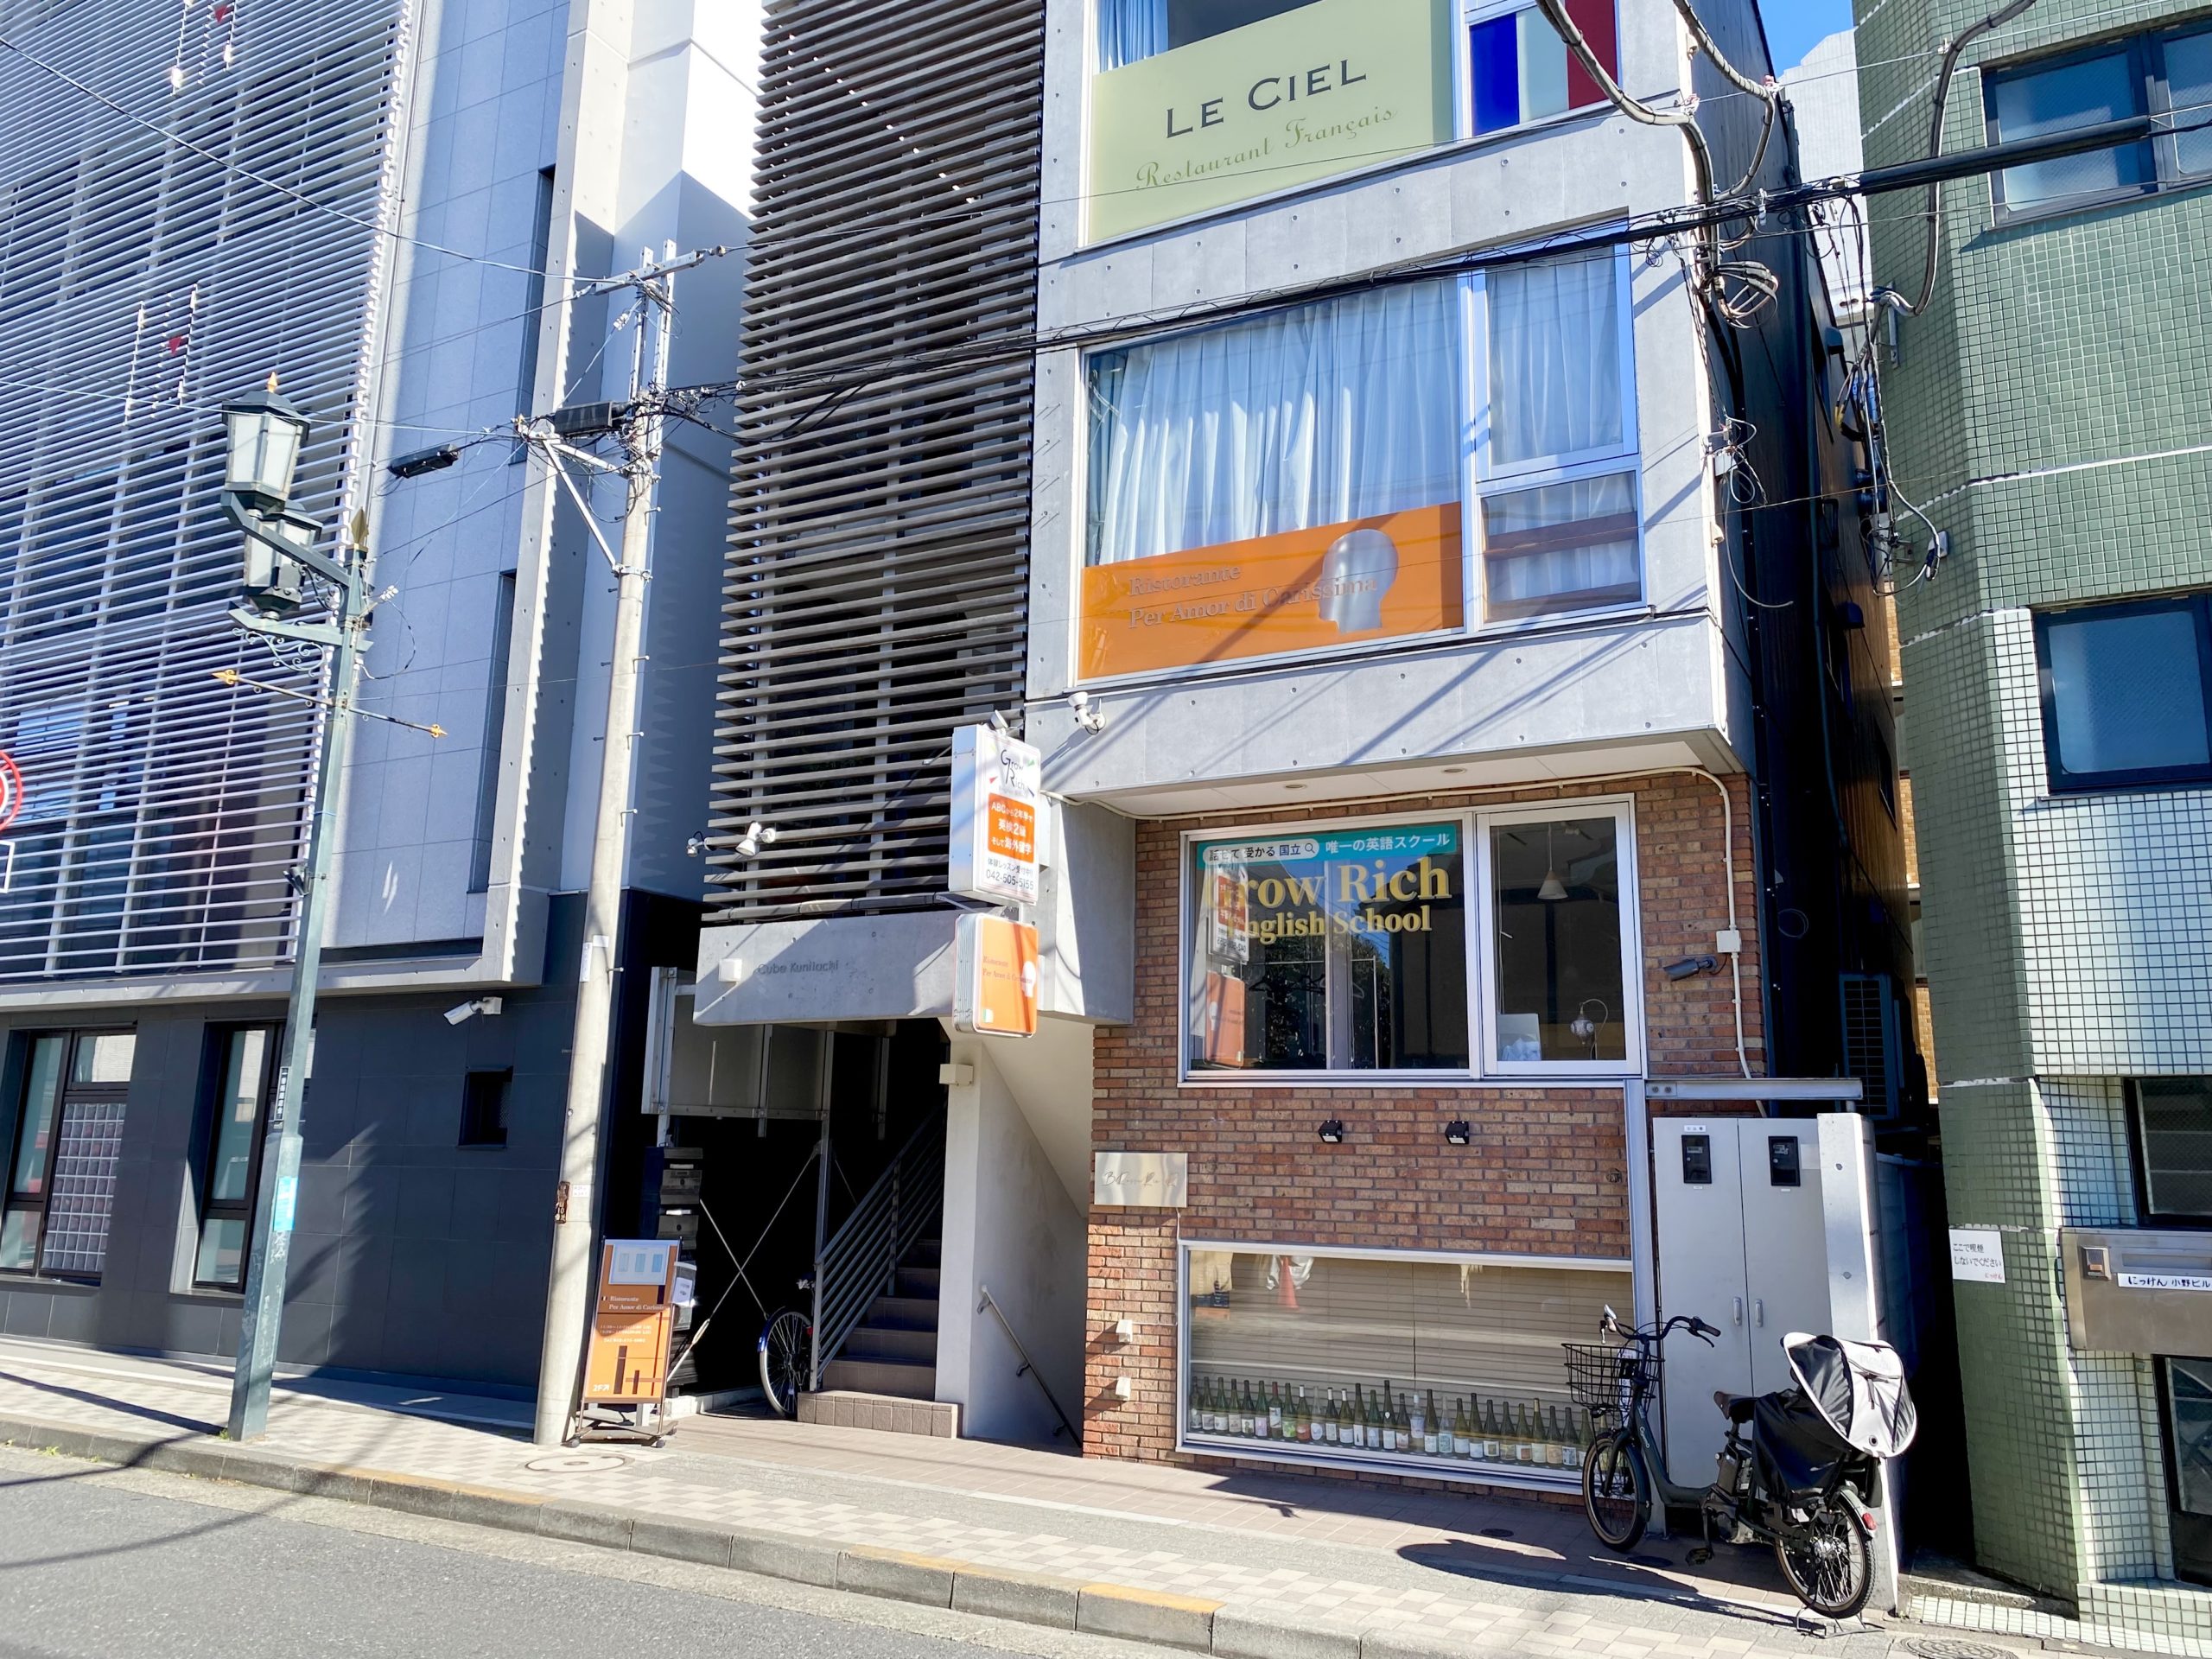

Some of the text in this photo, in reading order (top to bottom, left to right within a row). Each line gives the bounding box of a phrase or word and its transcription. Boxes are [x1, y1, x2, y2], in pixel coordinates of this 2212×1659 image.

[1166, 59, 1367, 139] LE CIEL
[1135, 105, 1399, 191] Restaurant Français
[1128, 565, 1242, 597] Ristorante
[1128, 575, 1378, 629] Per Amor di Carissima
[1244, 845, 1275, 859] 受かる
[1280, 843, 1301, 856] 国立
[1325, 832, 1451, 855] 唯一の英語スクール
[1206, 868, 1325, 909] row
[1337, 857, 1452, 904] Rich
[1223, 909, 1326, 945] nglish
[1333, 905, 1433, 935] School
[1954, 1255, 2002, 1268] しないでください
[2127, 1275, 2211, 1288] にっけん 小野ビル
